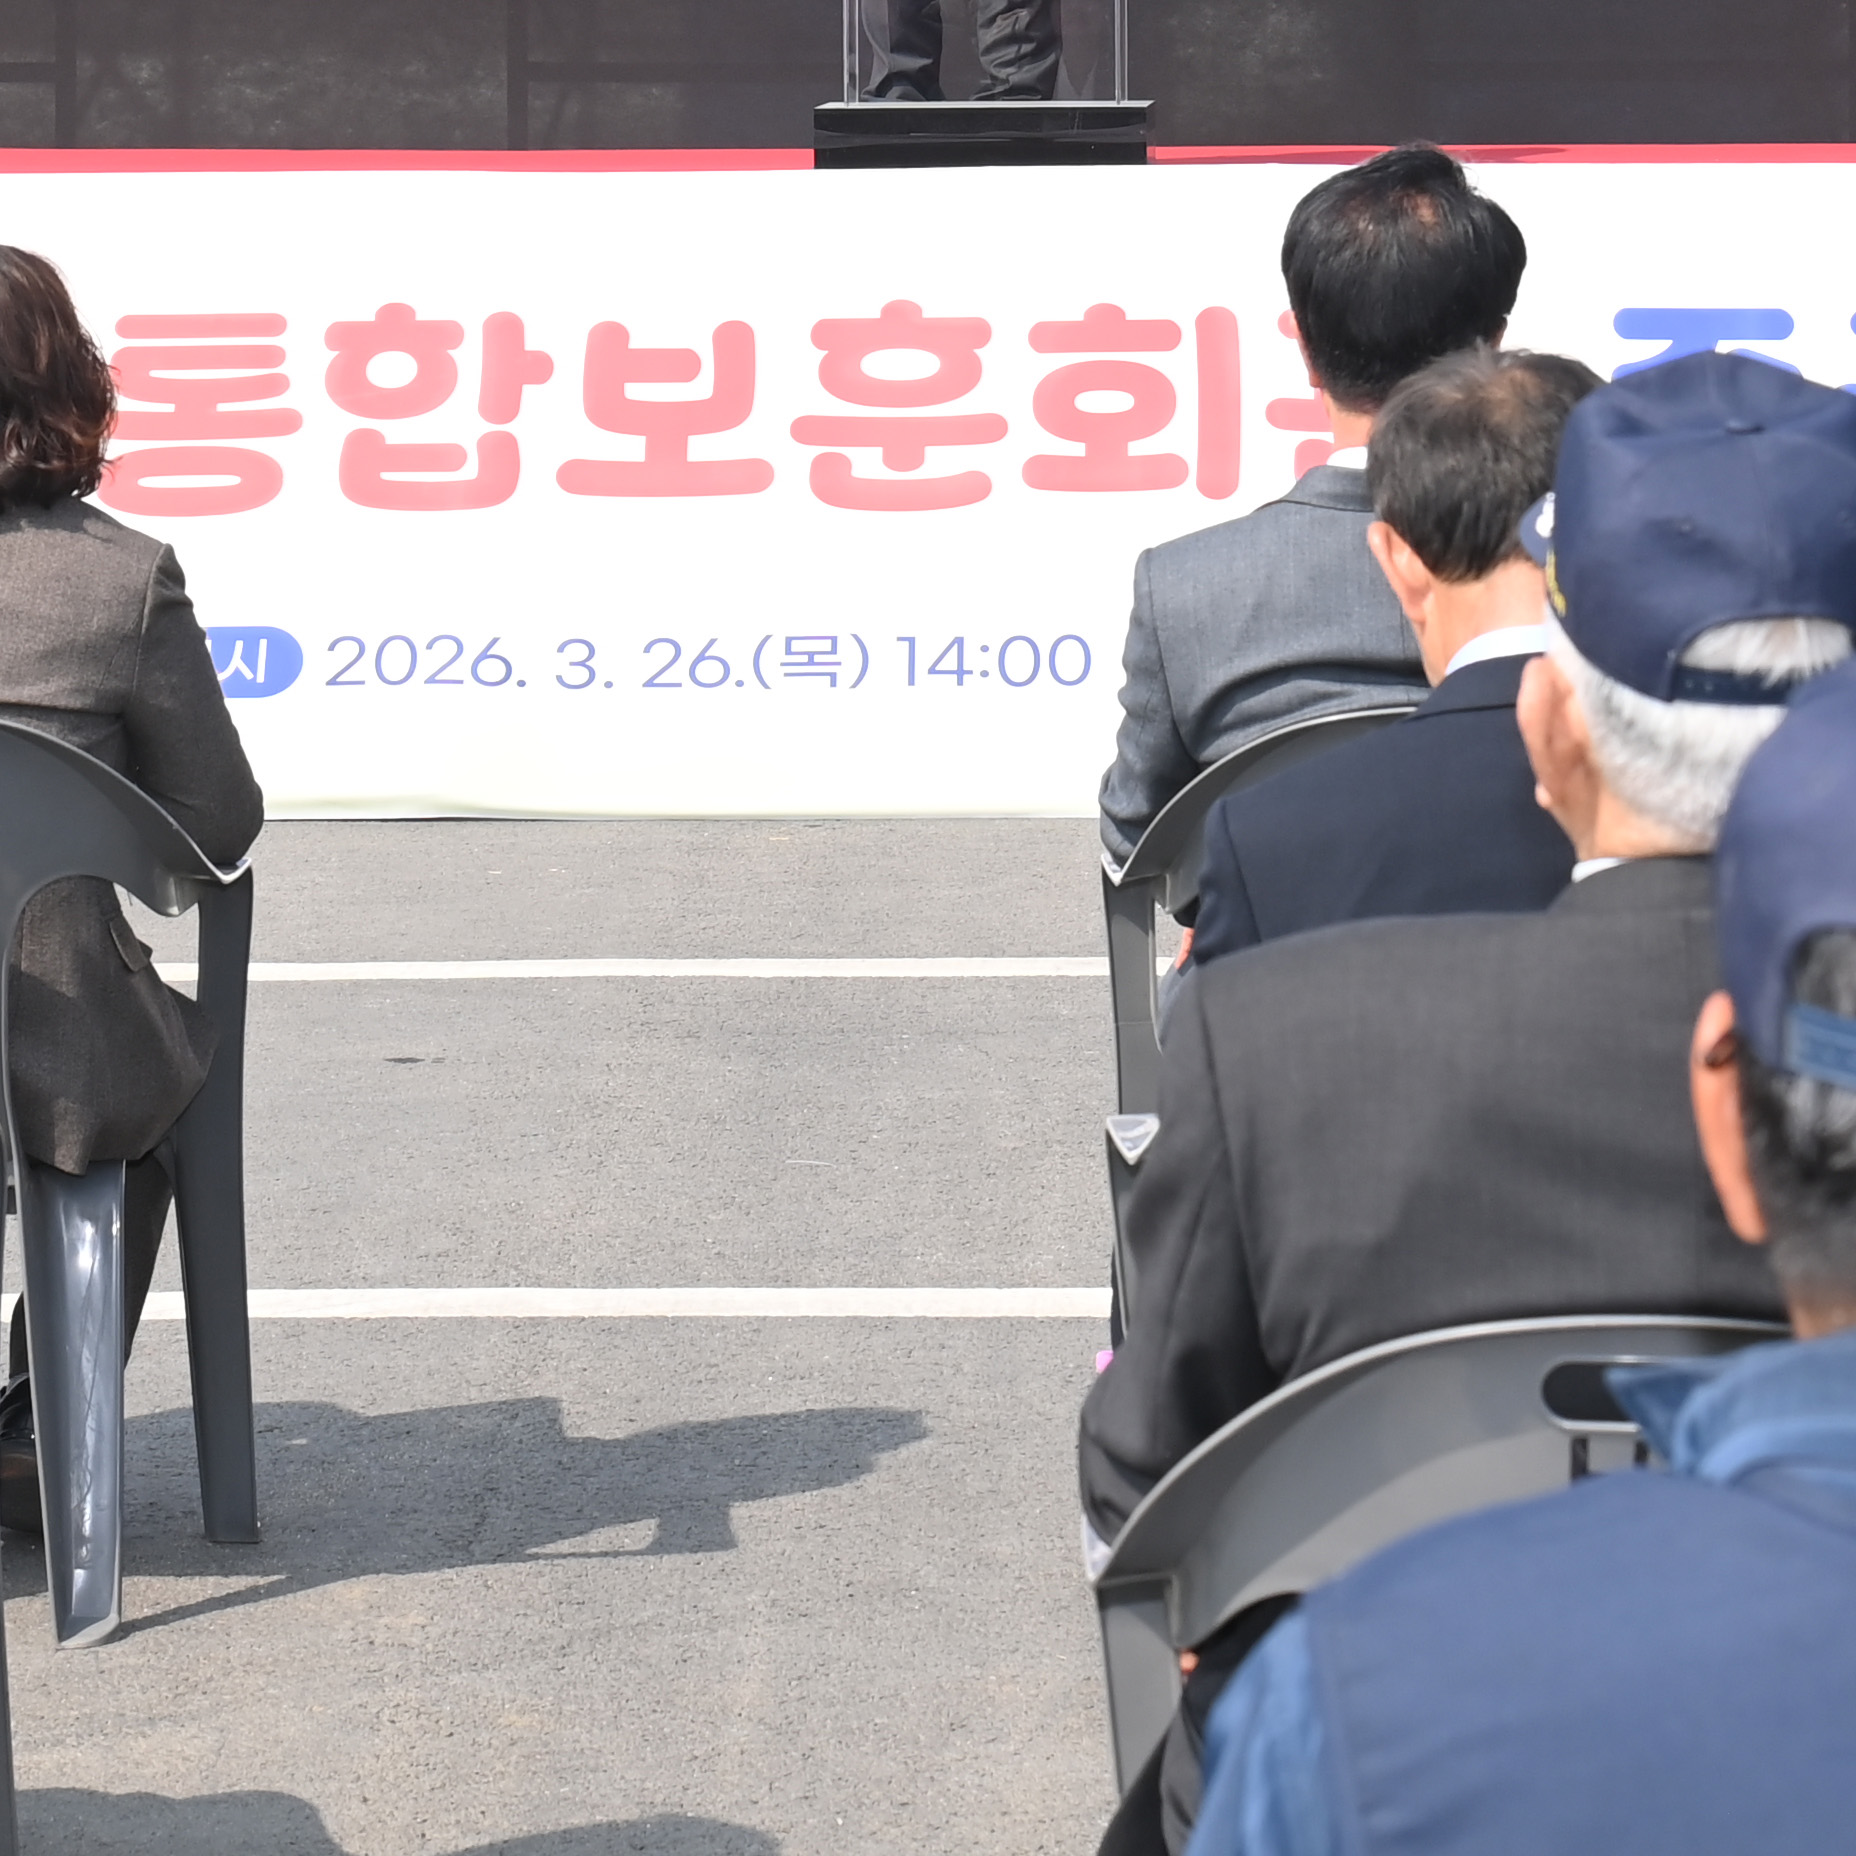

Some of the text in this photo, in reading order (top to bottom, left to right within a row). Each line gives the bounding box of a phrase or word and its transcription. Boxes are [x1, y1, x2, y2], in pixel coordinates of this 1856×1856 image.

[325, 633, 527, 689] 2026.
[554, 636, 613, 691] 3.
[641, 632, 869, 692] 26.(목)
[897, 632, 1091, 688] 14:00
